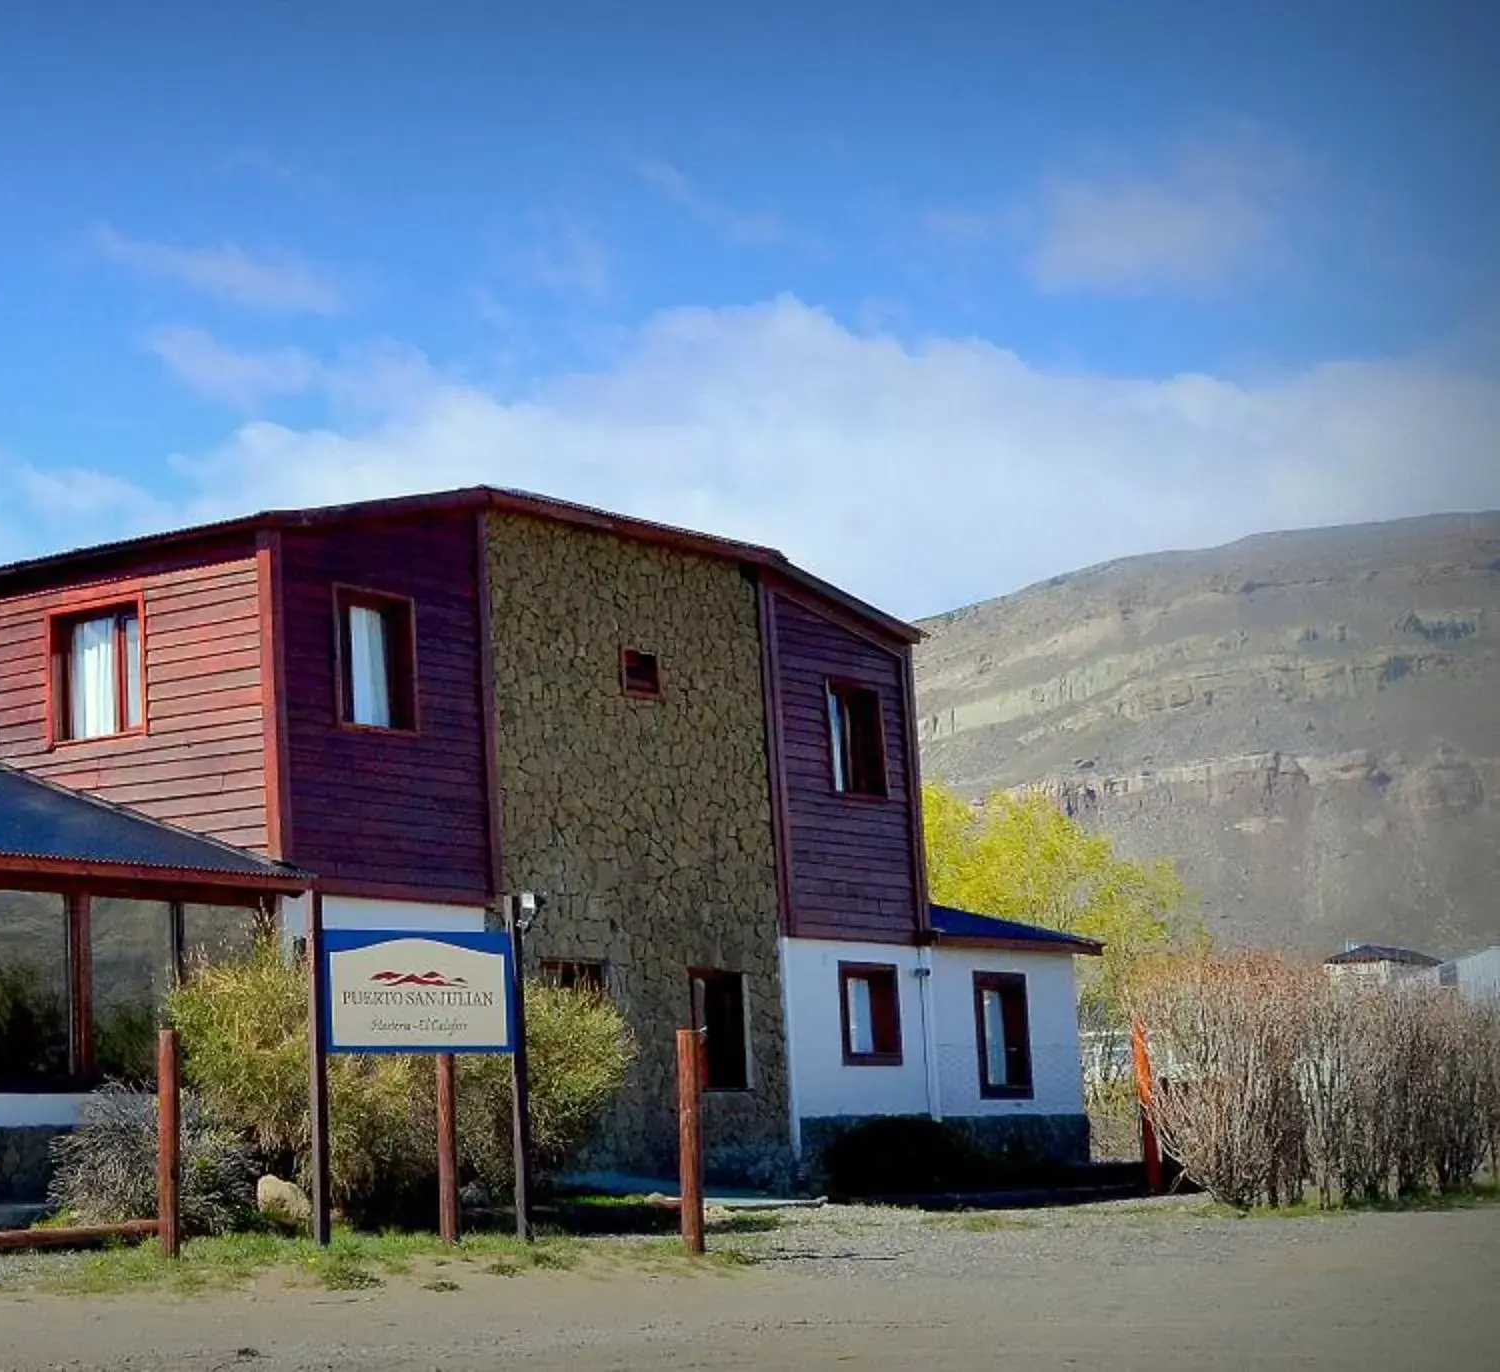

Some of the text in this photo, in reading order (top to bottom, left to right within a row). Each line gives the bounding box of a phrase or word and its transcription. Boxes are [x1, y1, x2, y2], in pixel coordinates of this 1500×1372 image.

[342, 991, 494, 1007] PUERTO SAN JULIAN
